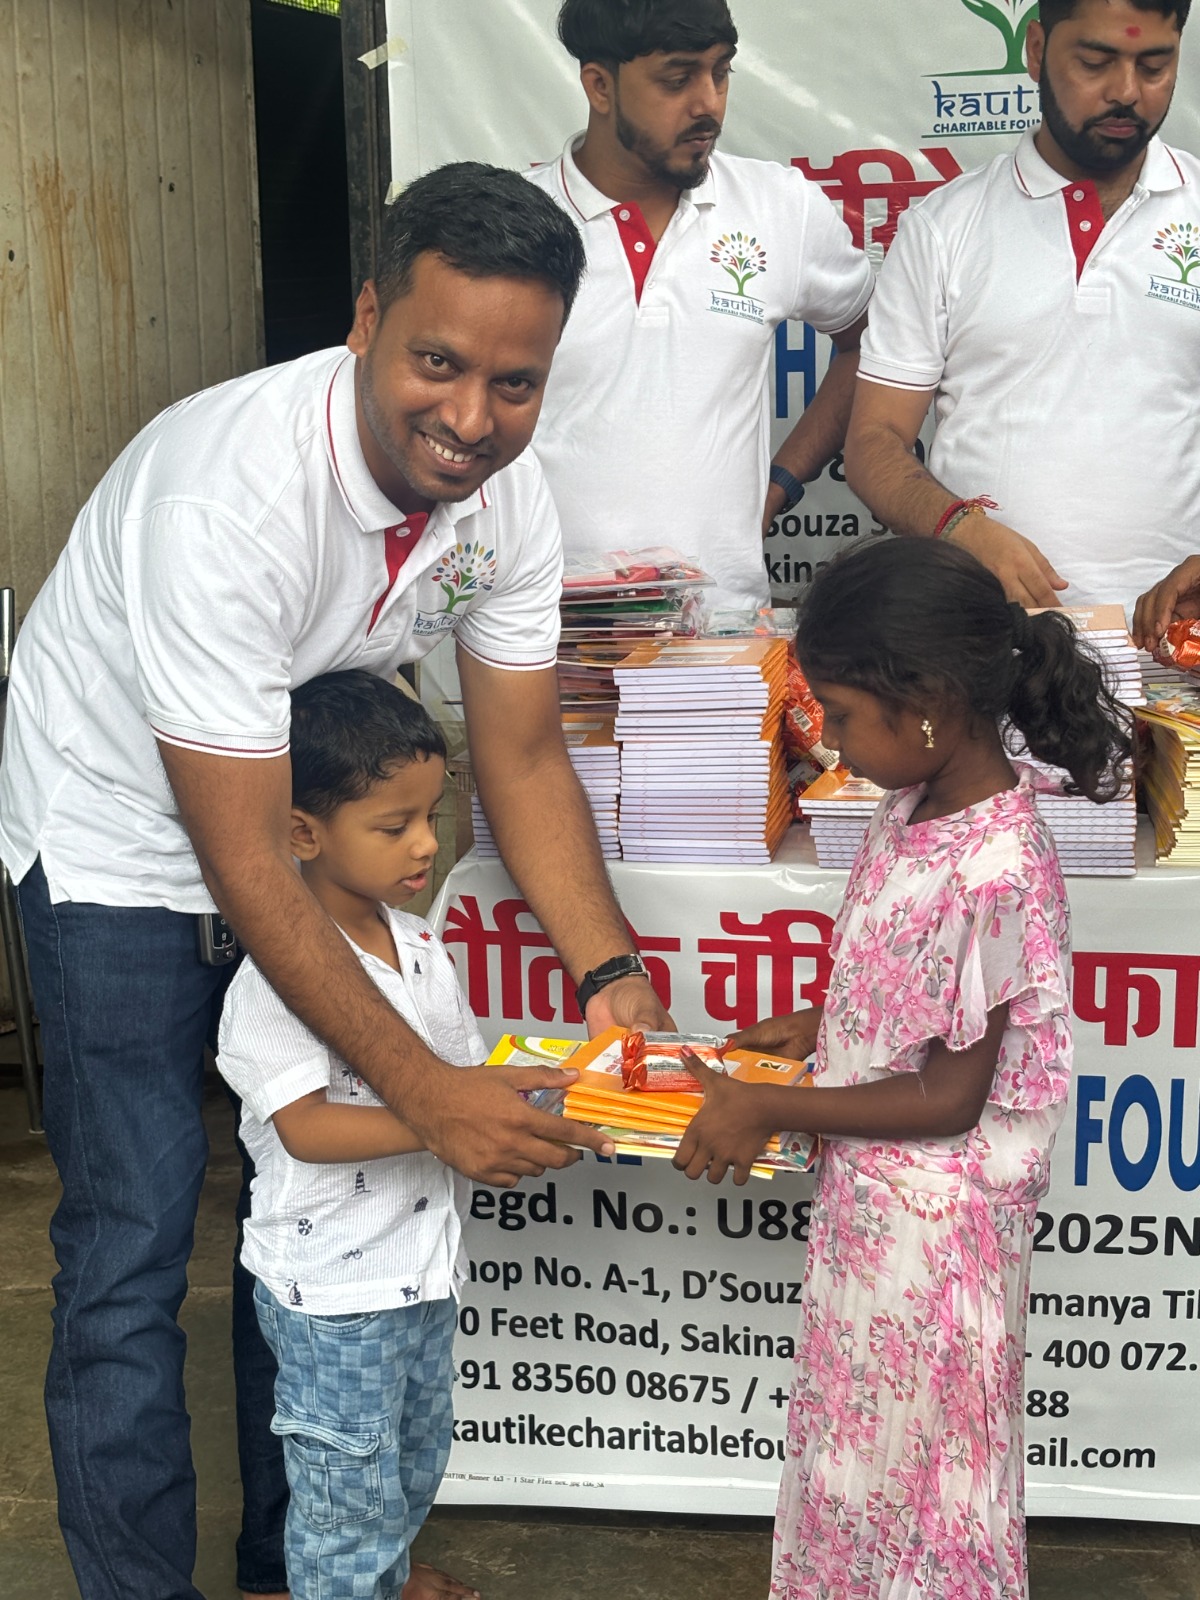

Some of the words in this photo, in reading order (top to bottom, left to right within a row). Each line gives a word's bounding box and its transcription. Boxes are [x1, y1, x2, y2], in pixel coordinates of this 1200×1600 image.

[931, 80, 1041, 118] kaut
[933, 120, 1006, 133] CHARITABLE
[710, 291, 765, 317] kautike
[593, 1189, 697, 1236] No.:
[534, 1256, 591, 1289] No.
[602, 1263, 671, 1303] A-1,
[491, 1307, 563, 1340] Feet
[575, 1312, 670, 1355] Road,
[680, 1323, 796, 1358] Sakina
[1043, 1340, 1110, 1369] 400
[1121, 1341, 1197, 1371] 072.
[511, 1361, 616, 1395] 83560
[626, 1369, 731, 1405] 08675
[1026, 1437, 1156, 1468] ail.com
[520, 1476, 535, 1484] Star
[537, 1477, 552, 1485] Flex
